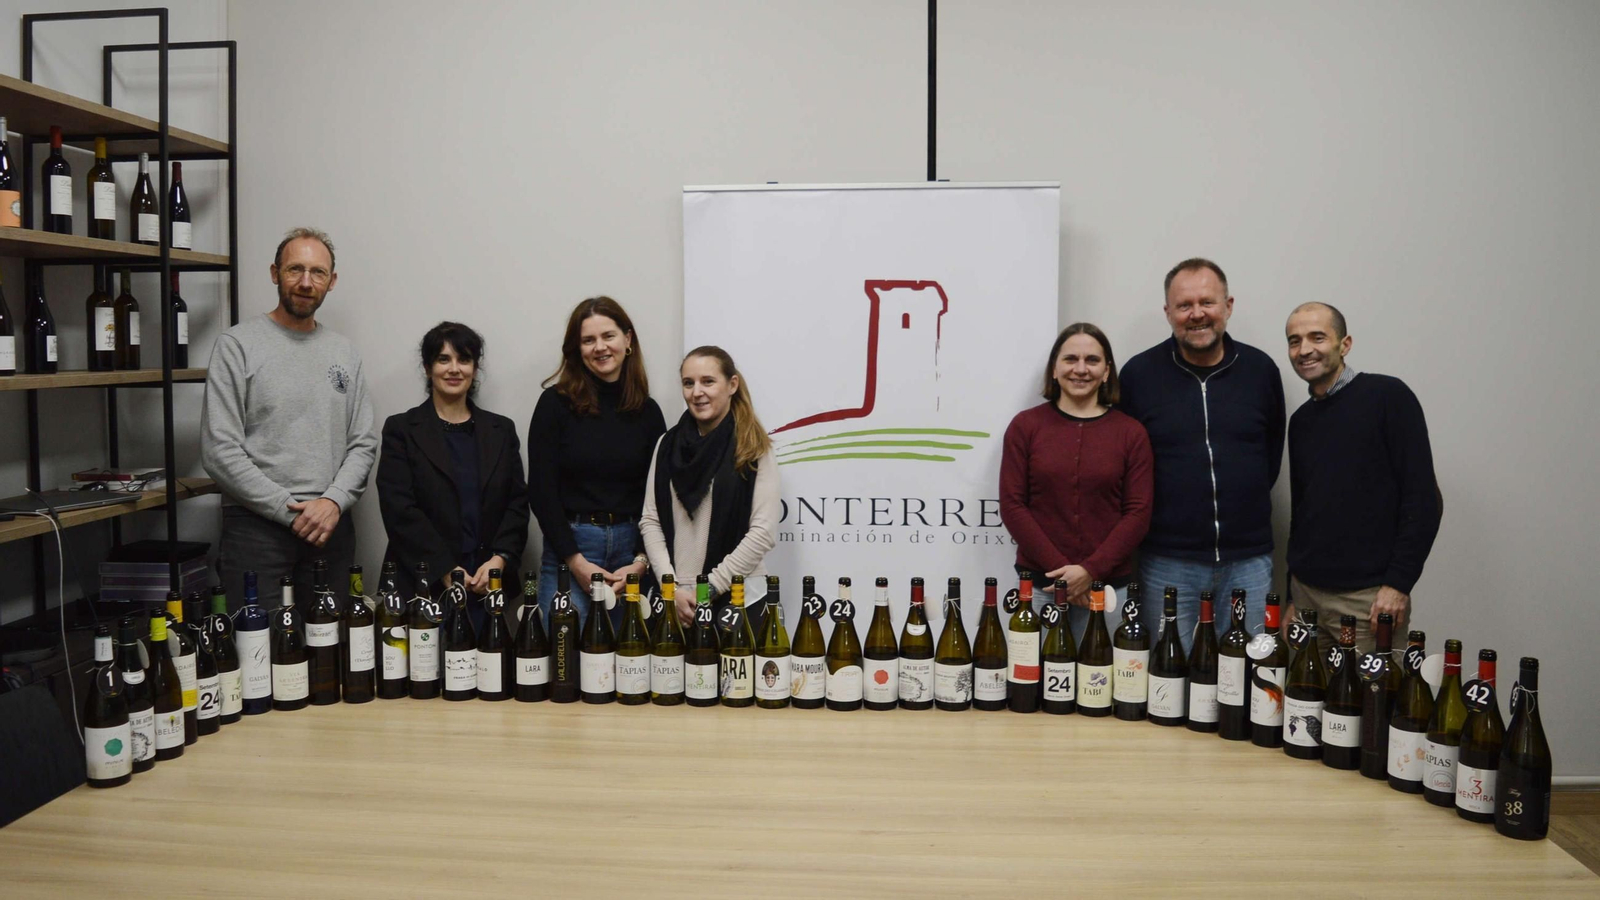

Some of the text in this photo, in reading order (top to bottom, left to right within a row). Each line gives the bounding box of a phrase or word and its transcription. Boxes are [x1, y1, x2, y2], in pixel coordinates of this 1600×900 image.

[910, 530, 935, 543] de
[328, 597, 335, 609] 9
[387, 594, 401, 609] 11
[450, 588, 463, 604] 13
[488, 594, 504, 608] 14
[554, 595, 568, 610] 16
[1007, 591, 1019, 609] 29
[425, 602, 443, 616] 12
[652, 597, 664, 613] 19
[804, 596, 822, 615] 23
[833, 602, 851, 617] 24
[1124, 600, 1139, 621] 32
[1234, 600, 1246, 621] 35
[283, 611, 293, 625] 8
[698, 608, 712, 622] 20
[721, 608, 739, 625] 21
[1042, 605, 1059, 623] 30
[215, 617, 225, 632] 6
[202, 631, 210, 645] 5
[1289, 624, 1308, 643] 37
[1250, 635, 1272, 654] 36
[1328, 647, 1343, 667] 38
[1359, 653, 1383, 673] 39
[1408, 649, 1424, 670] 40
[525, 665, 541, 673] LARA
[619, 666, 647, 675] TAPIAS
[653, 666, 680, 675] TAPIAS
[722, 657, 747, 681] ARA
[106, 670, 114, 687] 1
[1047, 675, 1071, 693] 24
[200, 690, 220, 711] 24
[1465, 684, 1490, 705] 42
[1328, 721, 1347, 733] LARA
[1473, 779, 1482, 795] 3
[1504, 800, 1523, 816] 38
